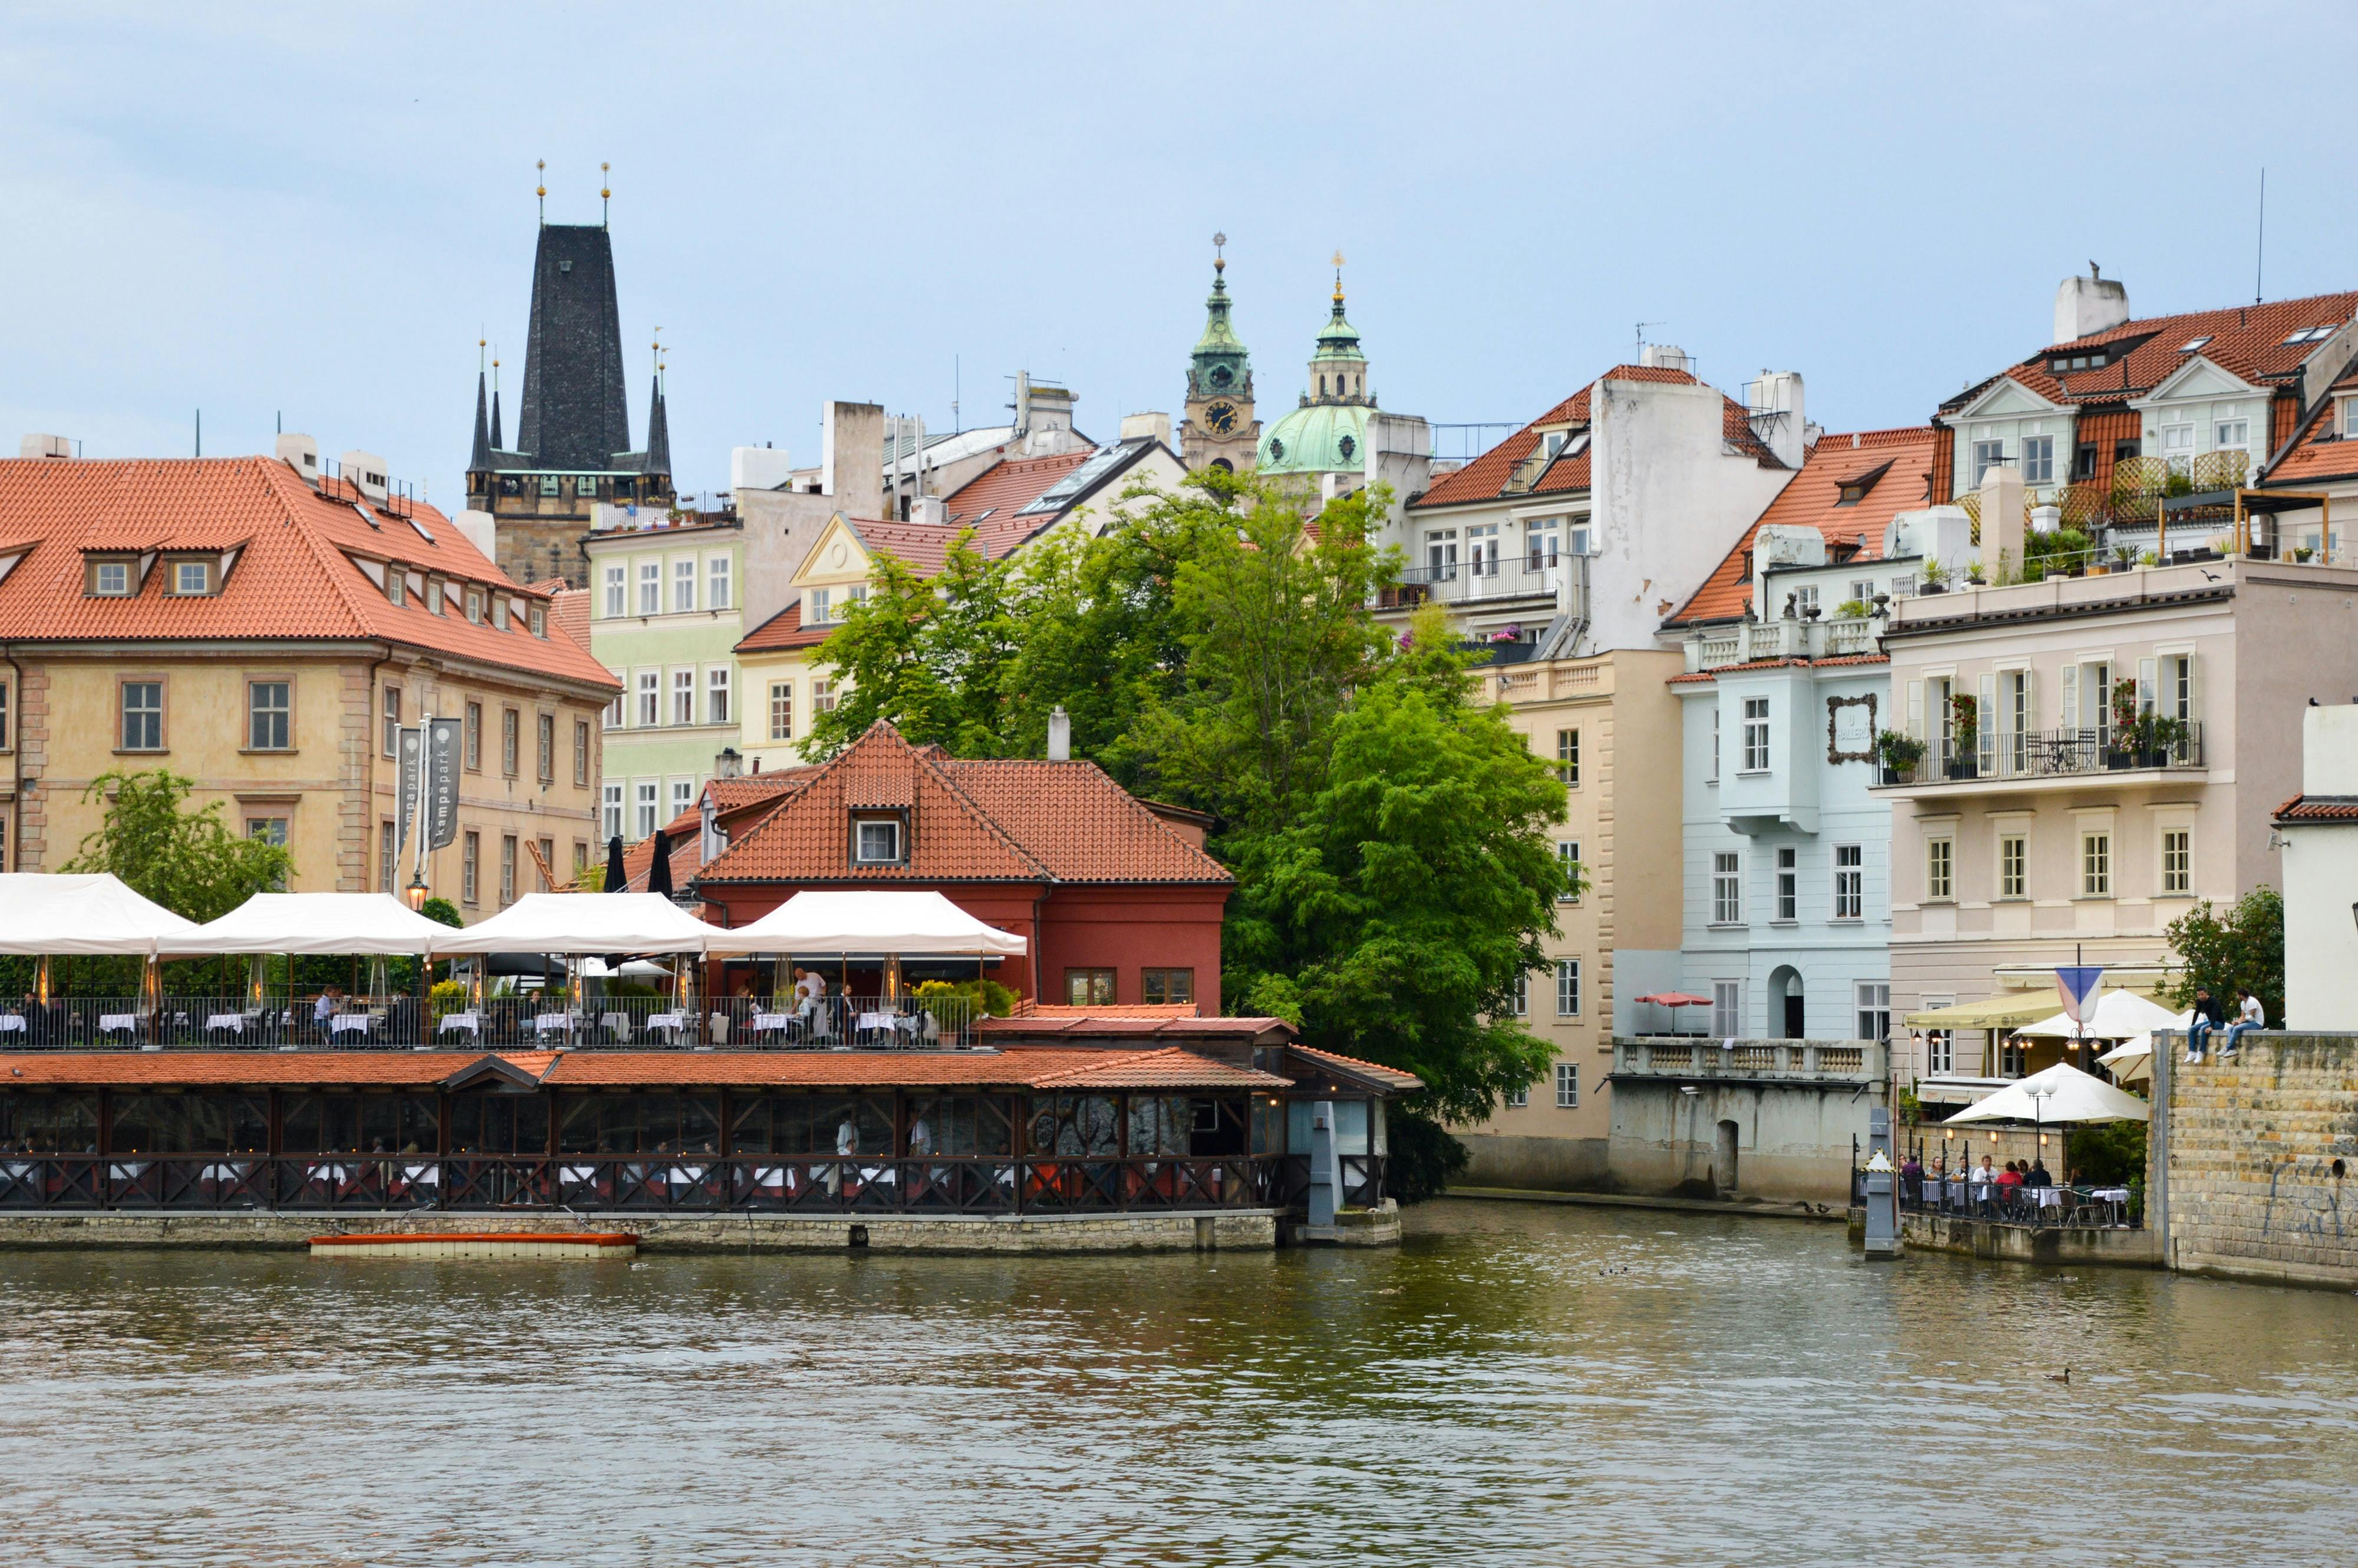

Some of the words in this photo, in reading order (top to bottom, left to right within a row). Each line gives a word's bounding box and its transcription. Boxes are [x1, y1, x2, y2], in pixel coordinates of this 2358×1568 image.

[1849, 714, 1855, 726] U
[404, 759, 417, 840] mpapark
[437, 750, 450, 836] kampapark
